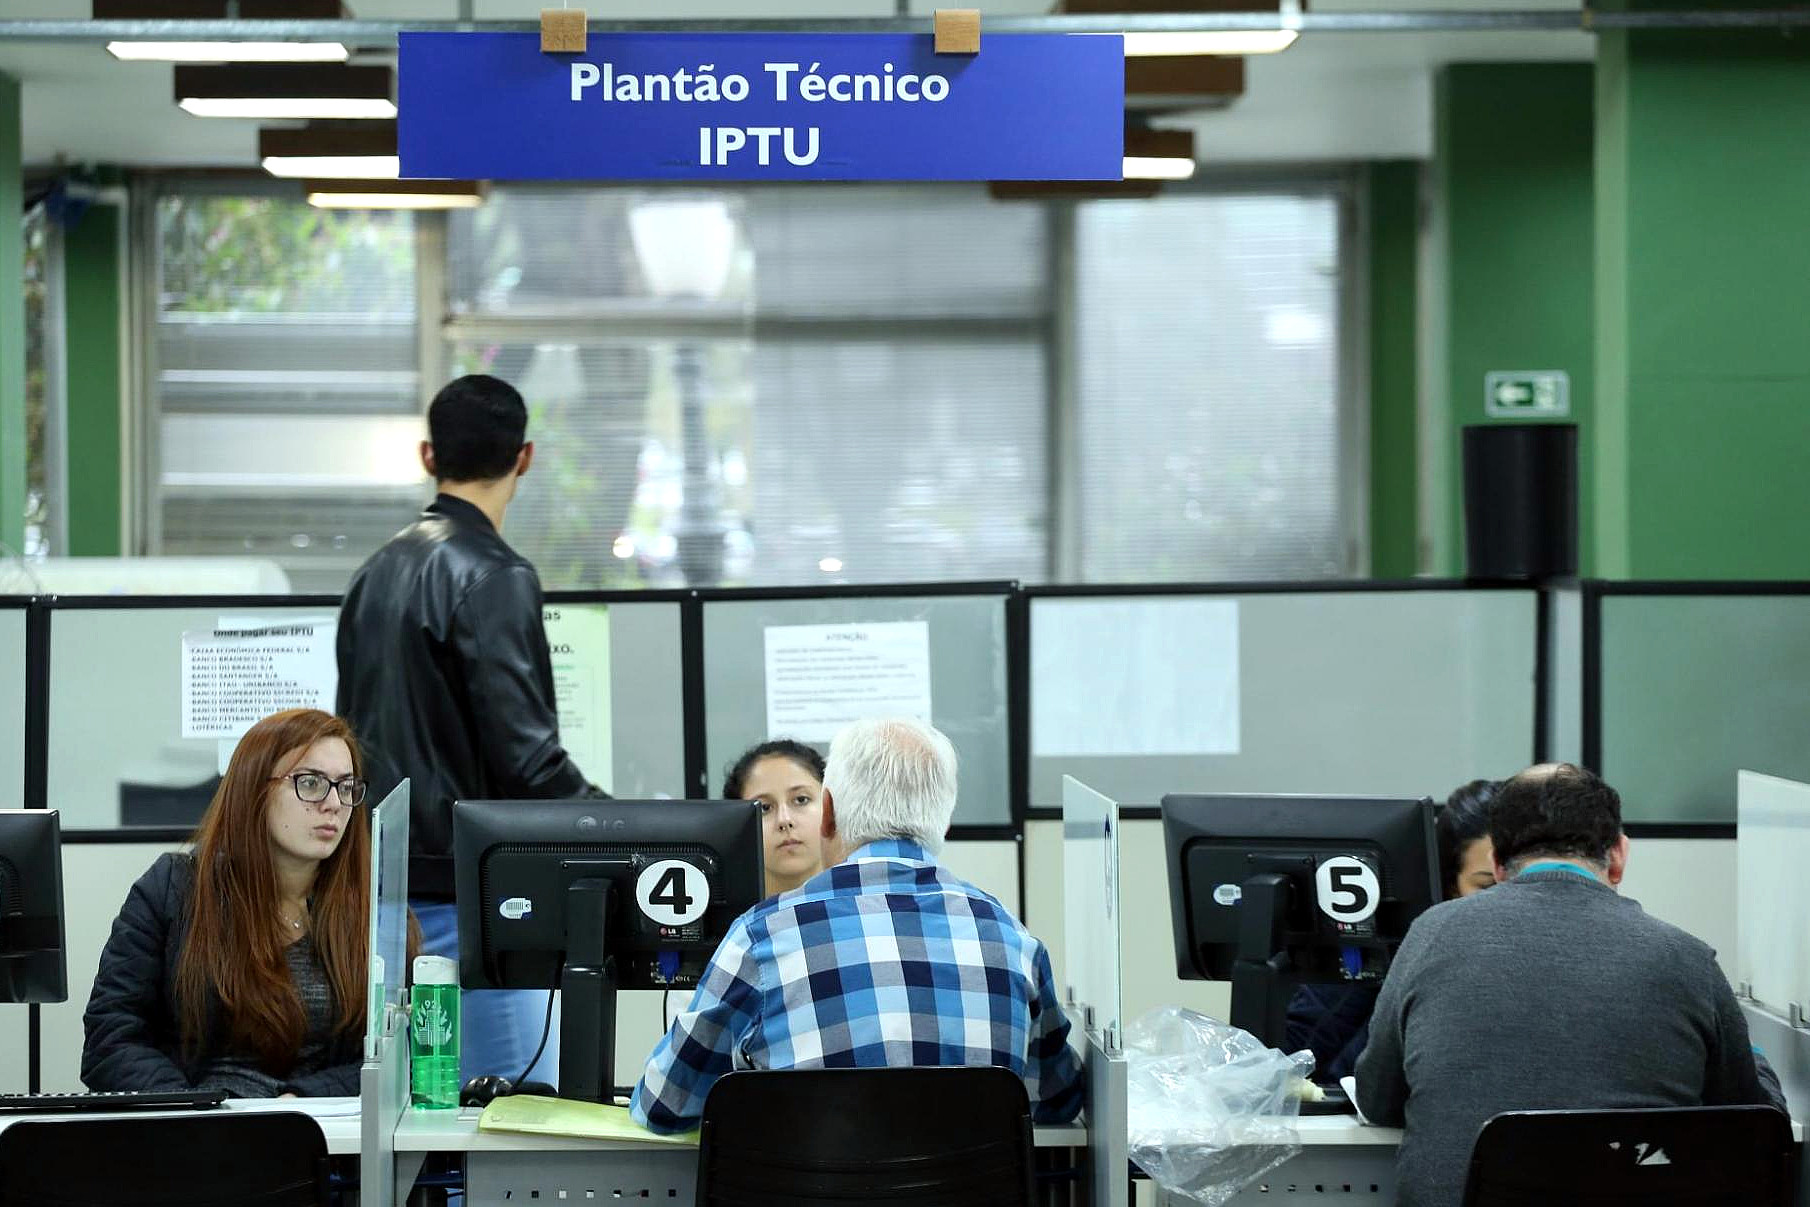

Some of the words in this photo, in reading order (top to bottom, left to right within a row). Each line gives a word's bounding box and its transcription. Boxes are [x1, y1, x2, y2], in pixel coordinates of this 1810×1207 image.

[571, 62, 749, 102] Plantão
[763, 61, 950, 103] Técnico
[699, 126, 820, 167] IPTU
[290, 625, 314, 636] IPTU
[191, 663, 217, 671] BANCO
[231, 663, 257, 671] BRASIL
[649, 867, 693, 914] 4
[1330, 866, 1368, 914] 5
